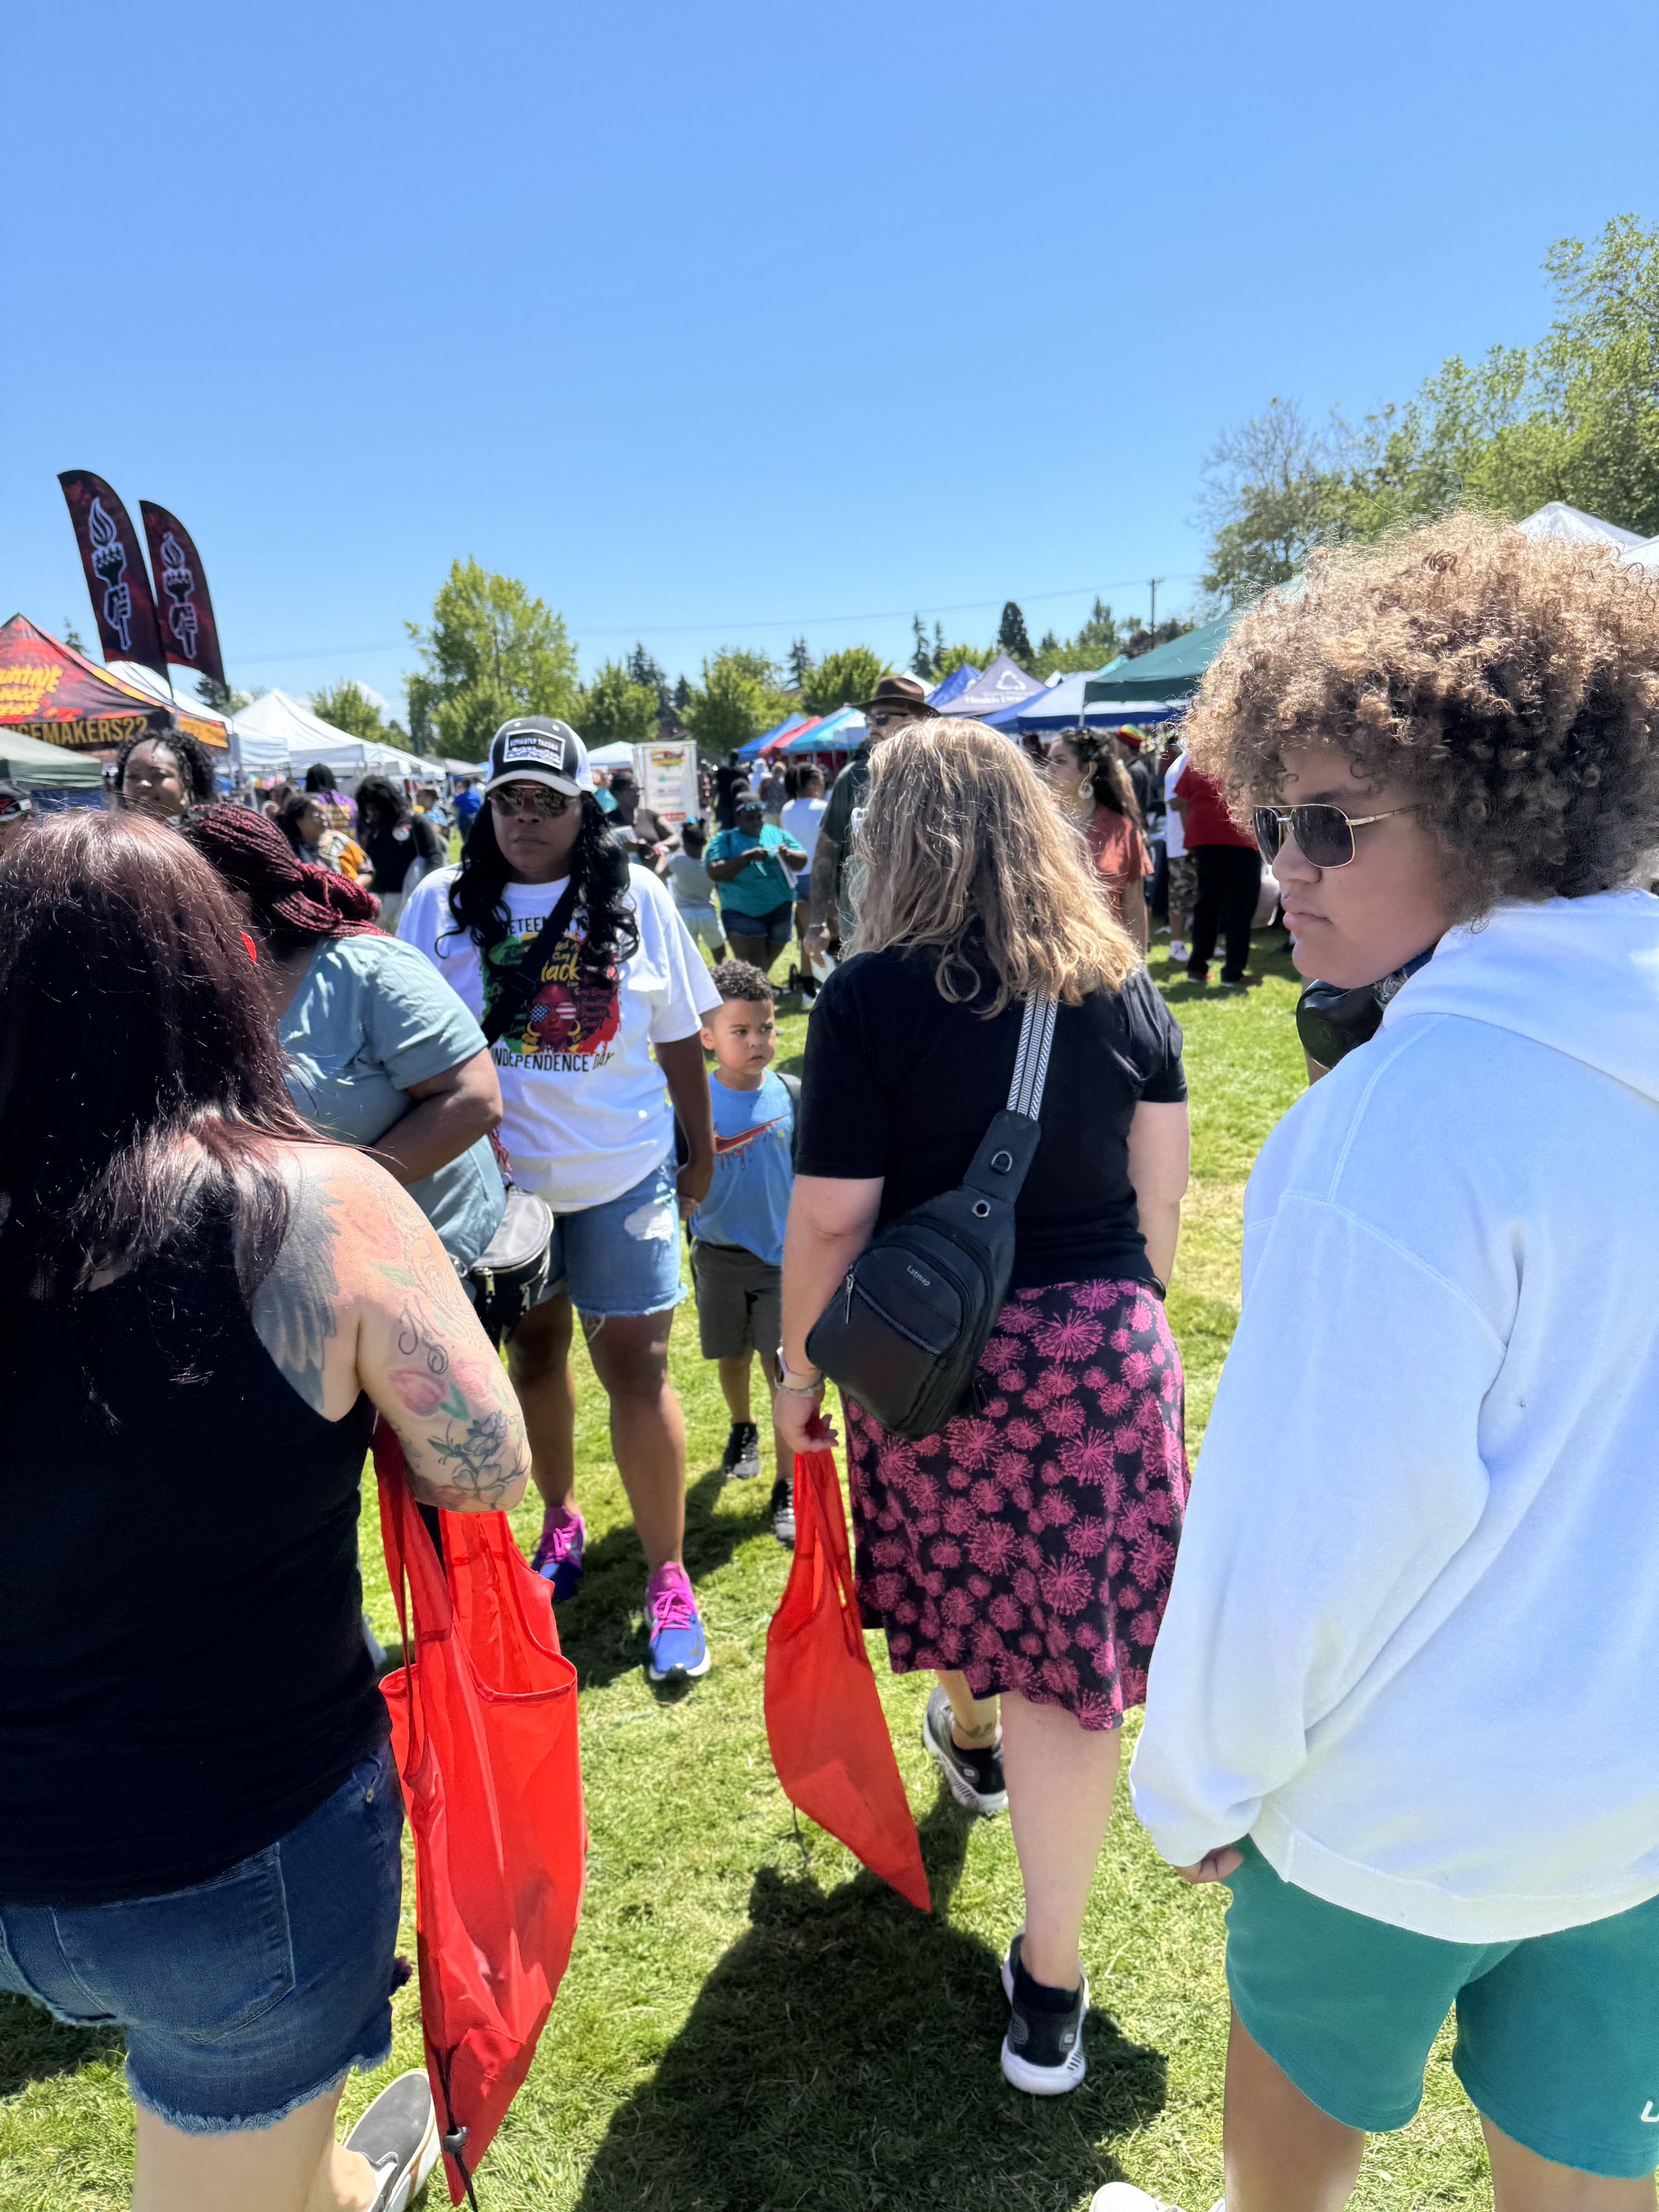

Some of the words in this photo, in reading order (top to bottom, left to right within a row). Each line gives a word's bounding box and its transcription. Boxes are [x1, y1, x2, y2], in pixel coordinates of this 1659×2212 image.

[540, 954, 581, 983] lack
[490, 1048, 589, 1072] INDEPENDENCE
[593, 1053, 614, 1070] DAY
